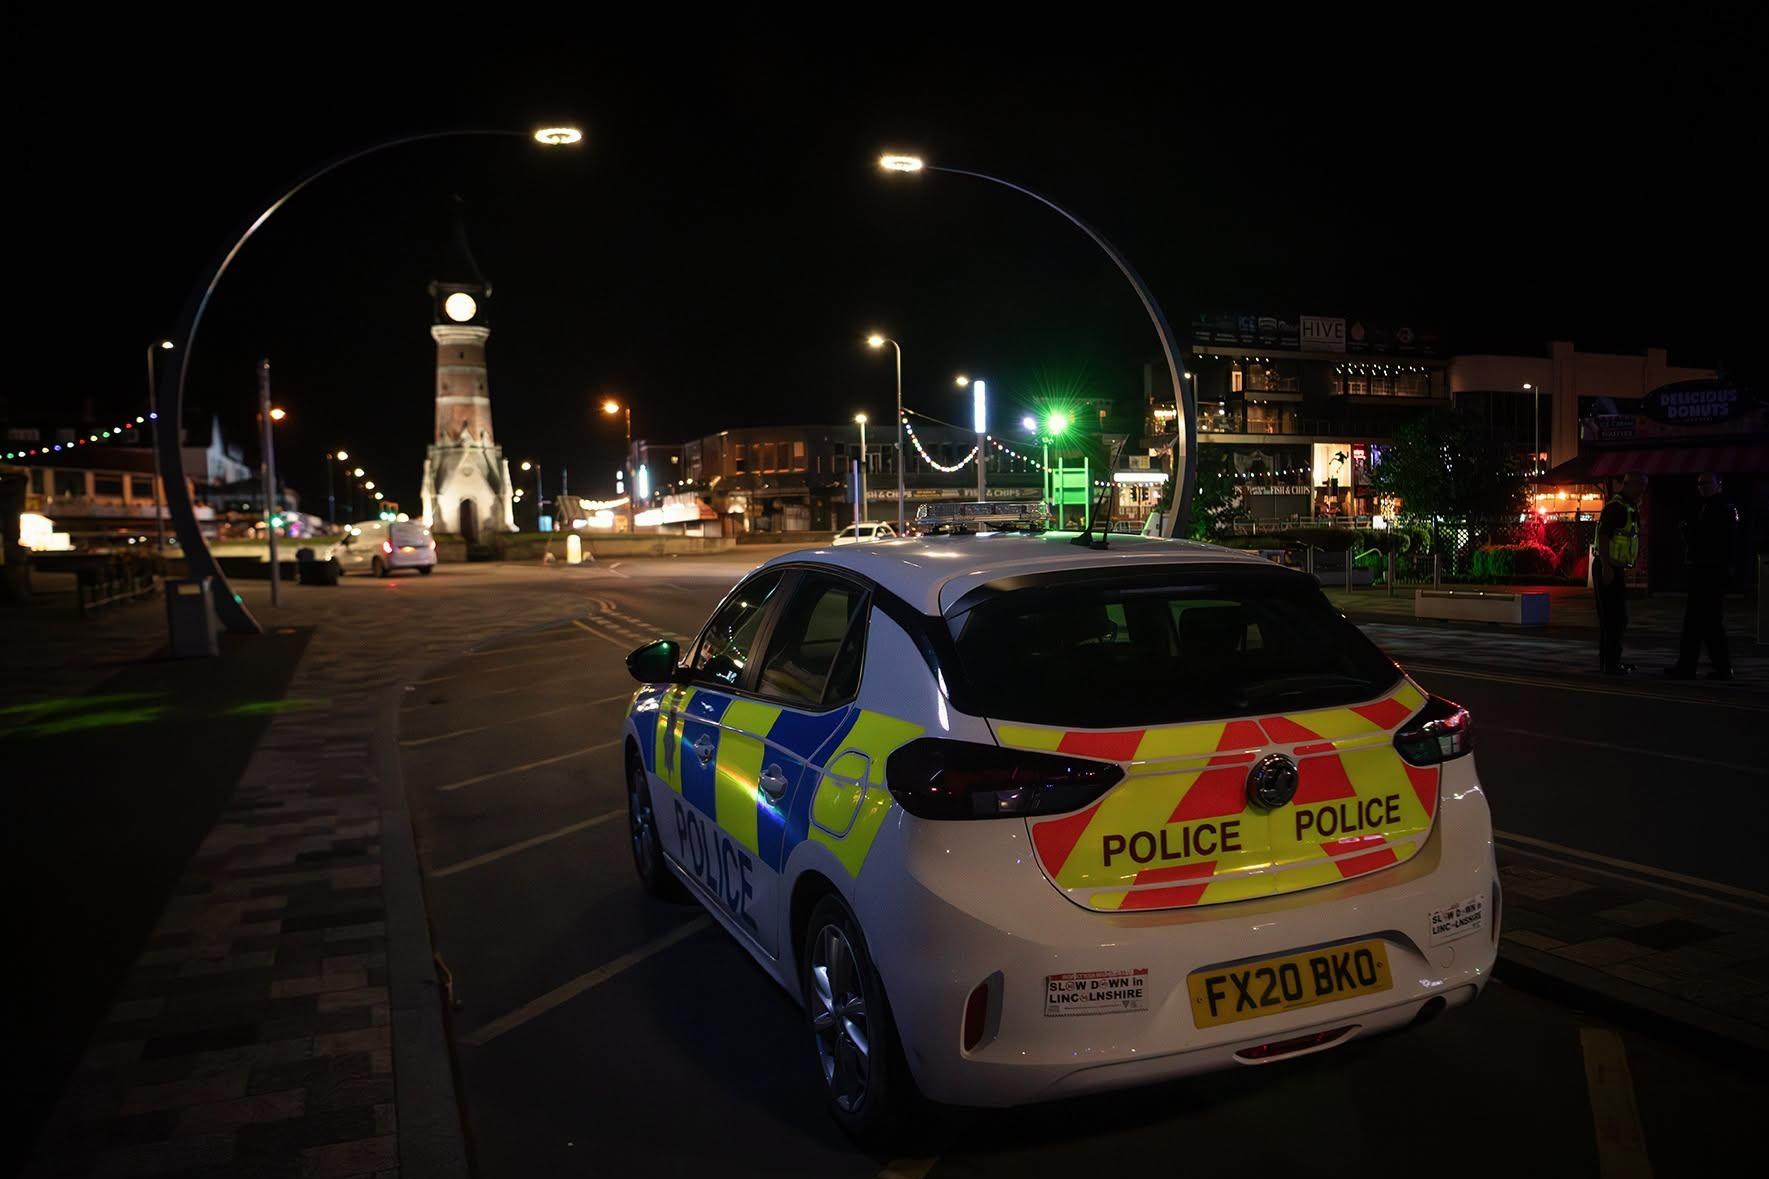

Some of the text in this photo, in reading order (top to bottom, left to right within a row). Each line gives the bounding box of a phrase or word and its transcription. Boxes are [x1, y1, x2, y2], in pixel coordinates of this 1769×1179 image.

[1303, 321, 1343, 339] HIVE
[1660, 388, 1737, 407] DELICIOUS
[1667, 403, 1728, 418] DONUTS
[1291, 486, 1311, 495] CHIPS
[1296, 794, 1401, 841] POLICE
[1103, 820, 1242, 867] POLICE
[675, 799, 756, 931] POLICE
[1049, 977, 1143, 992] SLOW DOWN in
[1205, 948, 1377, 1017] FX20 BKO
[1049, 989, 1143, 1003] LINCOLNSHIRE
